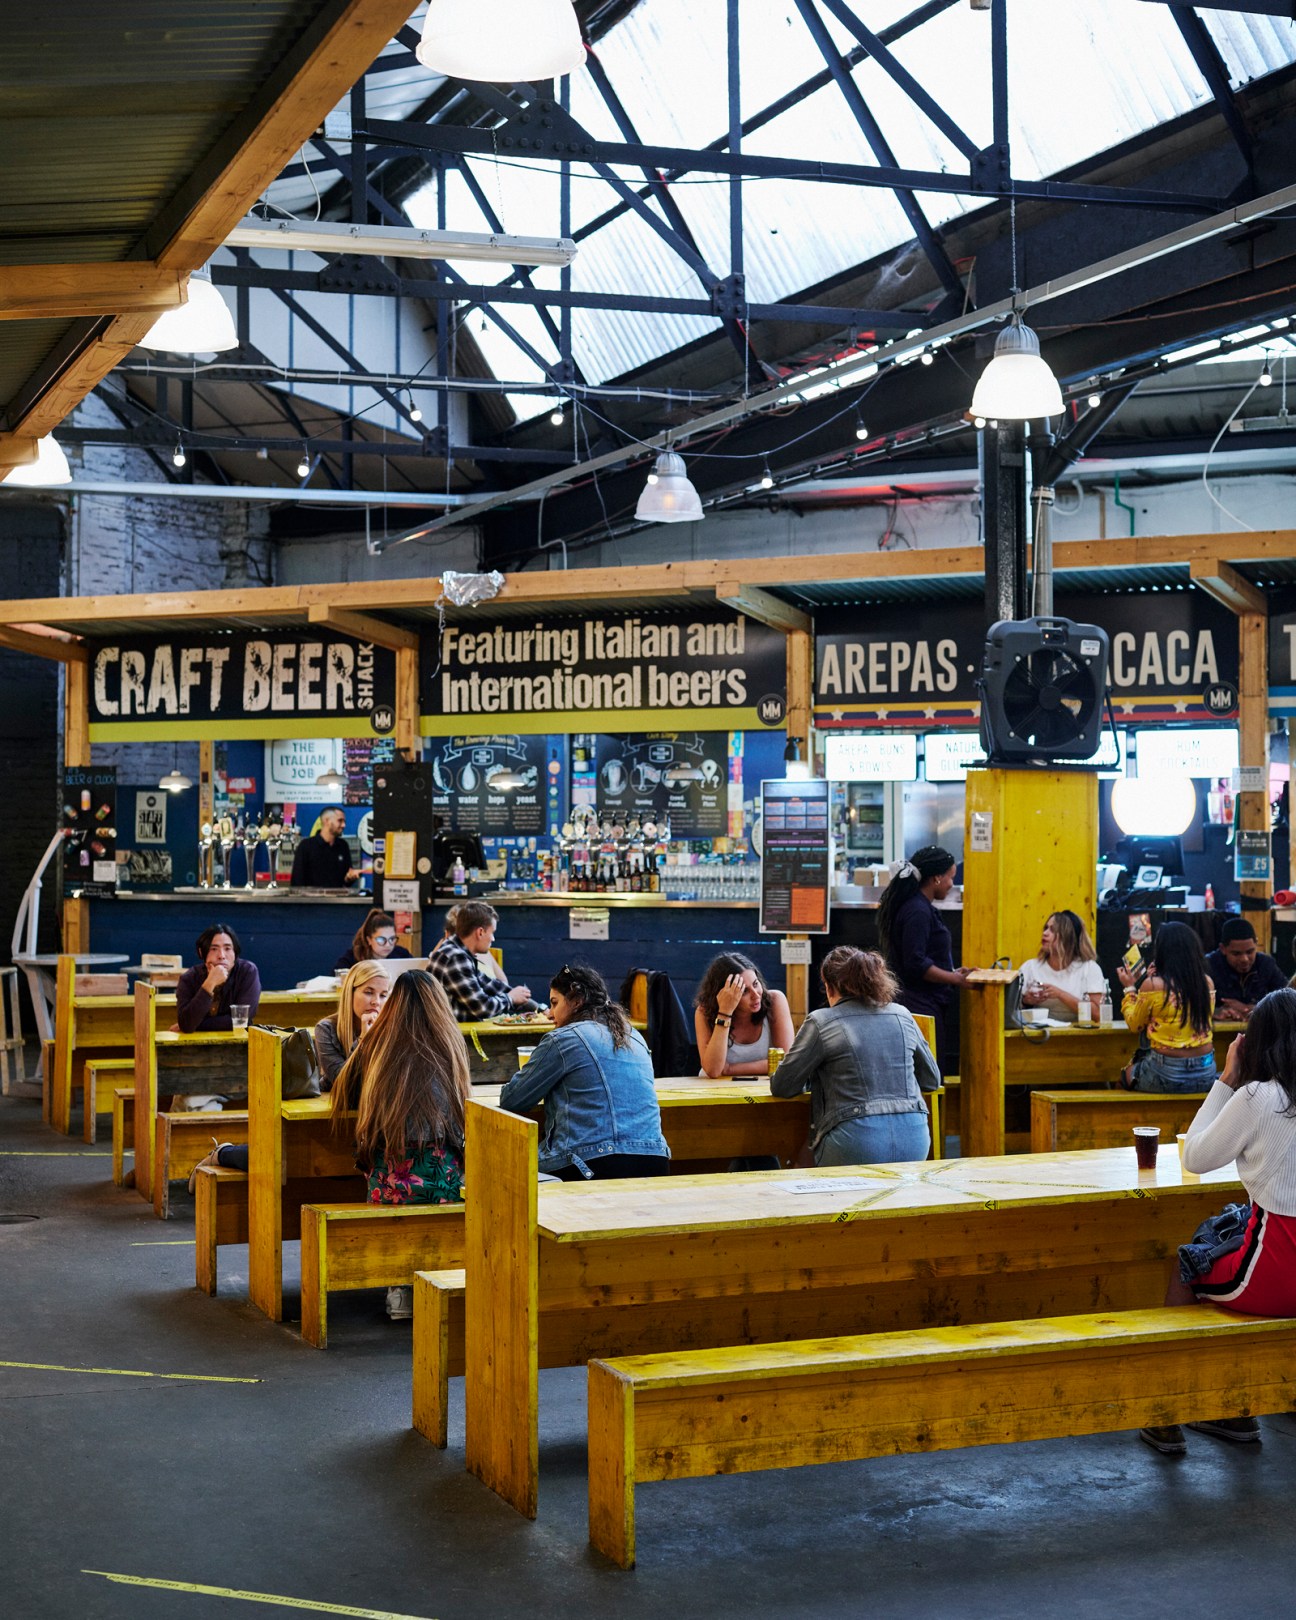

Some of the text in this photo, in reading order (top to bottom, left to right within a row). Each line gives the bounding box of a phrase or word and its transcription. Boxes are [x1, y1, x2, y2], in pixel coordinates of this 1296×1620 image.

[442, 615, 745, 666] Featuring Italian and
[1105, 629, 1219, 687] CACA
[819, 639, 958, 695] AREPAS
[94, 640, 355, 716] CRAFT BEER
[357, 643, 374, 710] SHACK
[442, 664, 748, 713] International beers
[292, 742, 315, 752] THE
[879, 743, 906, 756] BUNS
[280, 755, 326, 766] ITALIAN
[291, 768, 315, 778] JOB
[458, 796, 479, 804] water
[138, 810, 162, 824] STAFF
[139, 824, 162, 839] ONLY
[1254, 857, 1267, 871] £5
